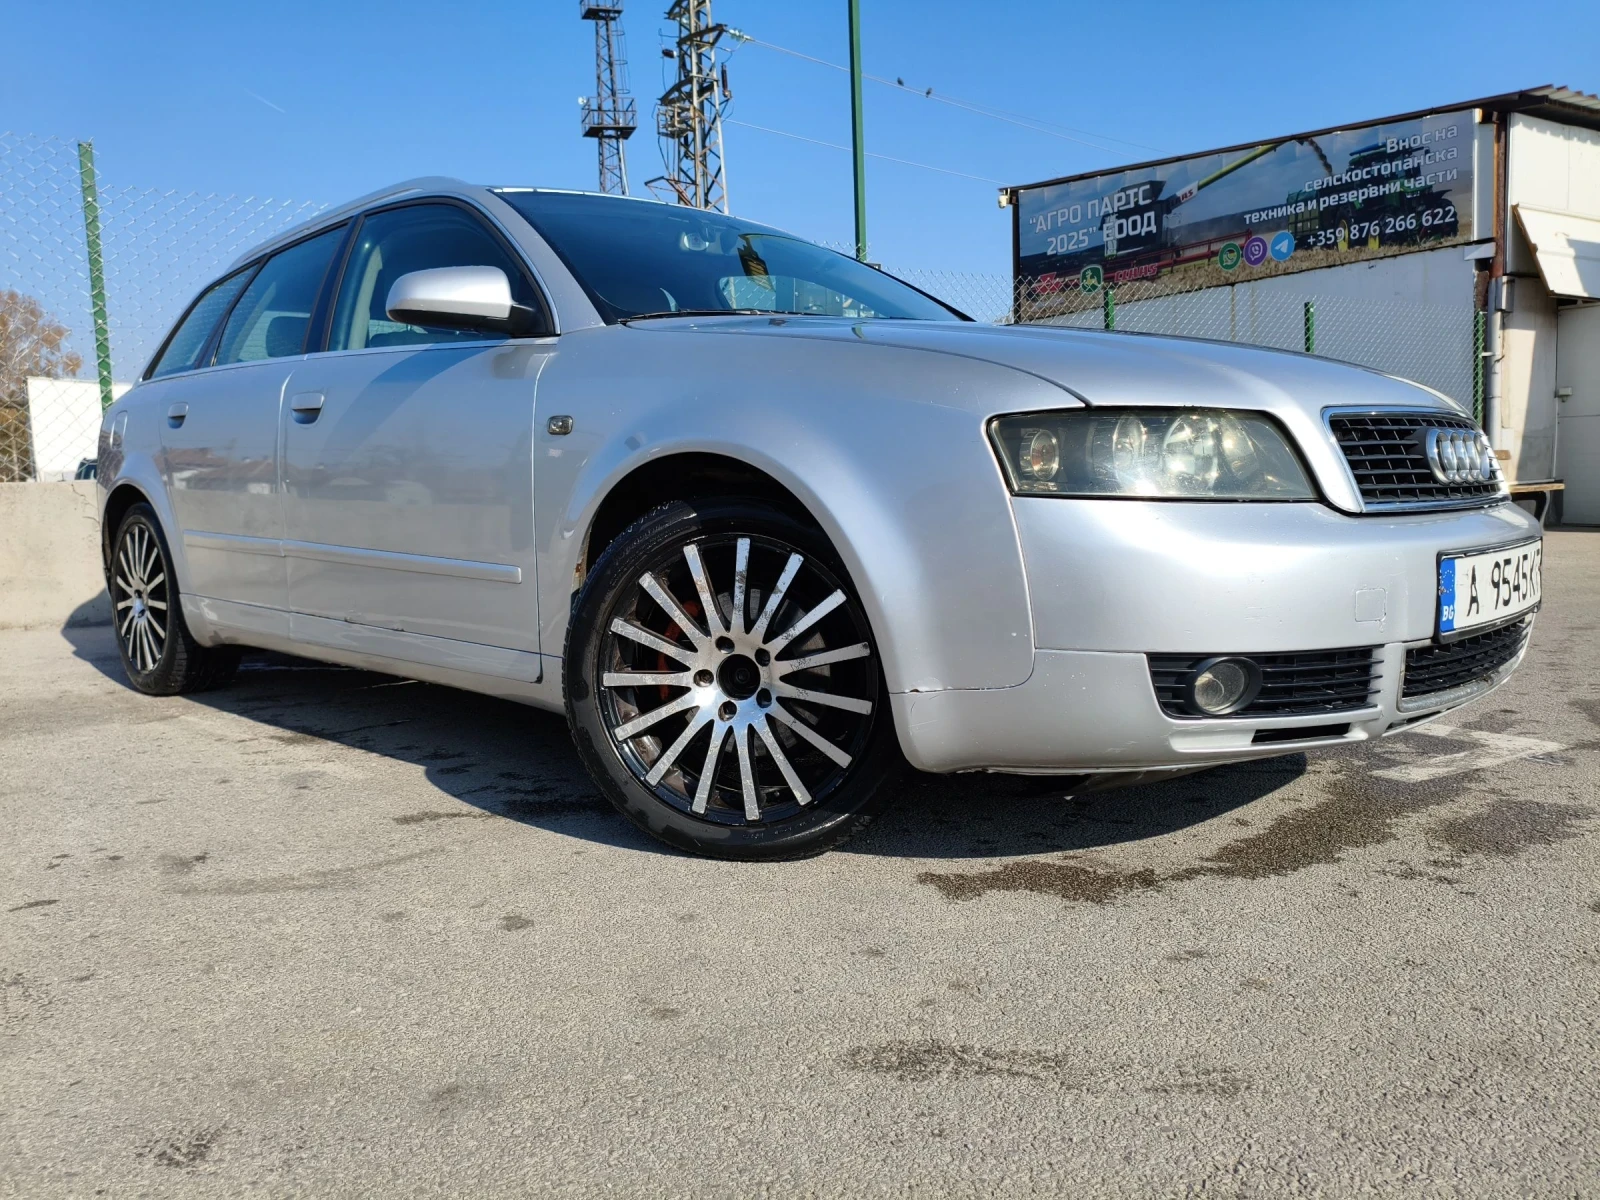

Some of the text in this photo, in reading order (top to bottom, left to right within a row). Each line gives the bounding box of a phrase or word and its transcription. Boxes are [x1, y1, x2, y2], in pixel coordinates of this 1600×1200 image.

[1386, 125, 1458, 153] Внос на
[1304, 147, 1458, 192] селскостопанска
[1088, 184, 1152, 219] ПАРТС
[1244, 168, 1458, 225] техника и резервни части
[1103, 211, 1157, 242] ЕООД
[1307, 206, 1455, 247] +359 876 266 622
[1114, 263, 1157, 282] CLAAS
[1467, 564, 1480, 617] A
[1442, 605, 1454, 621] BG
